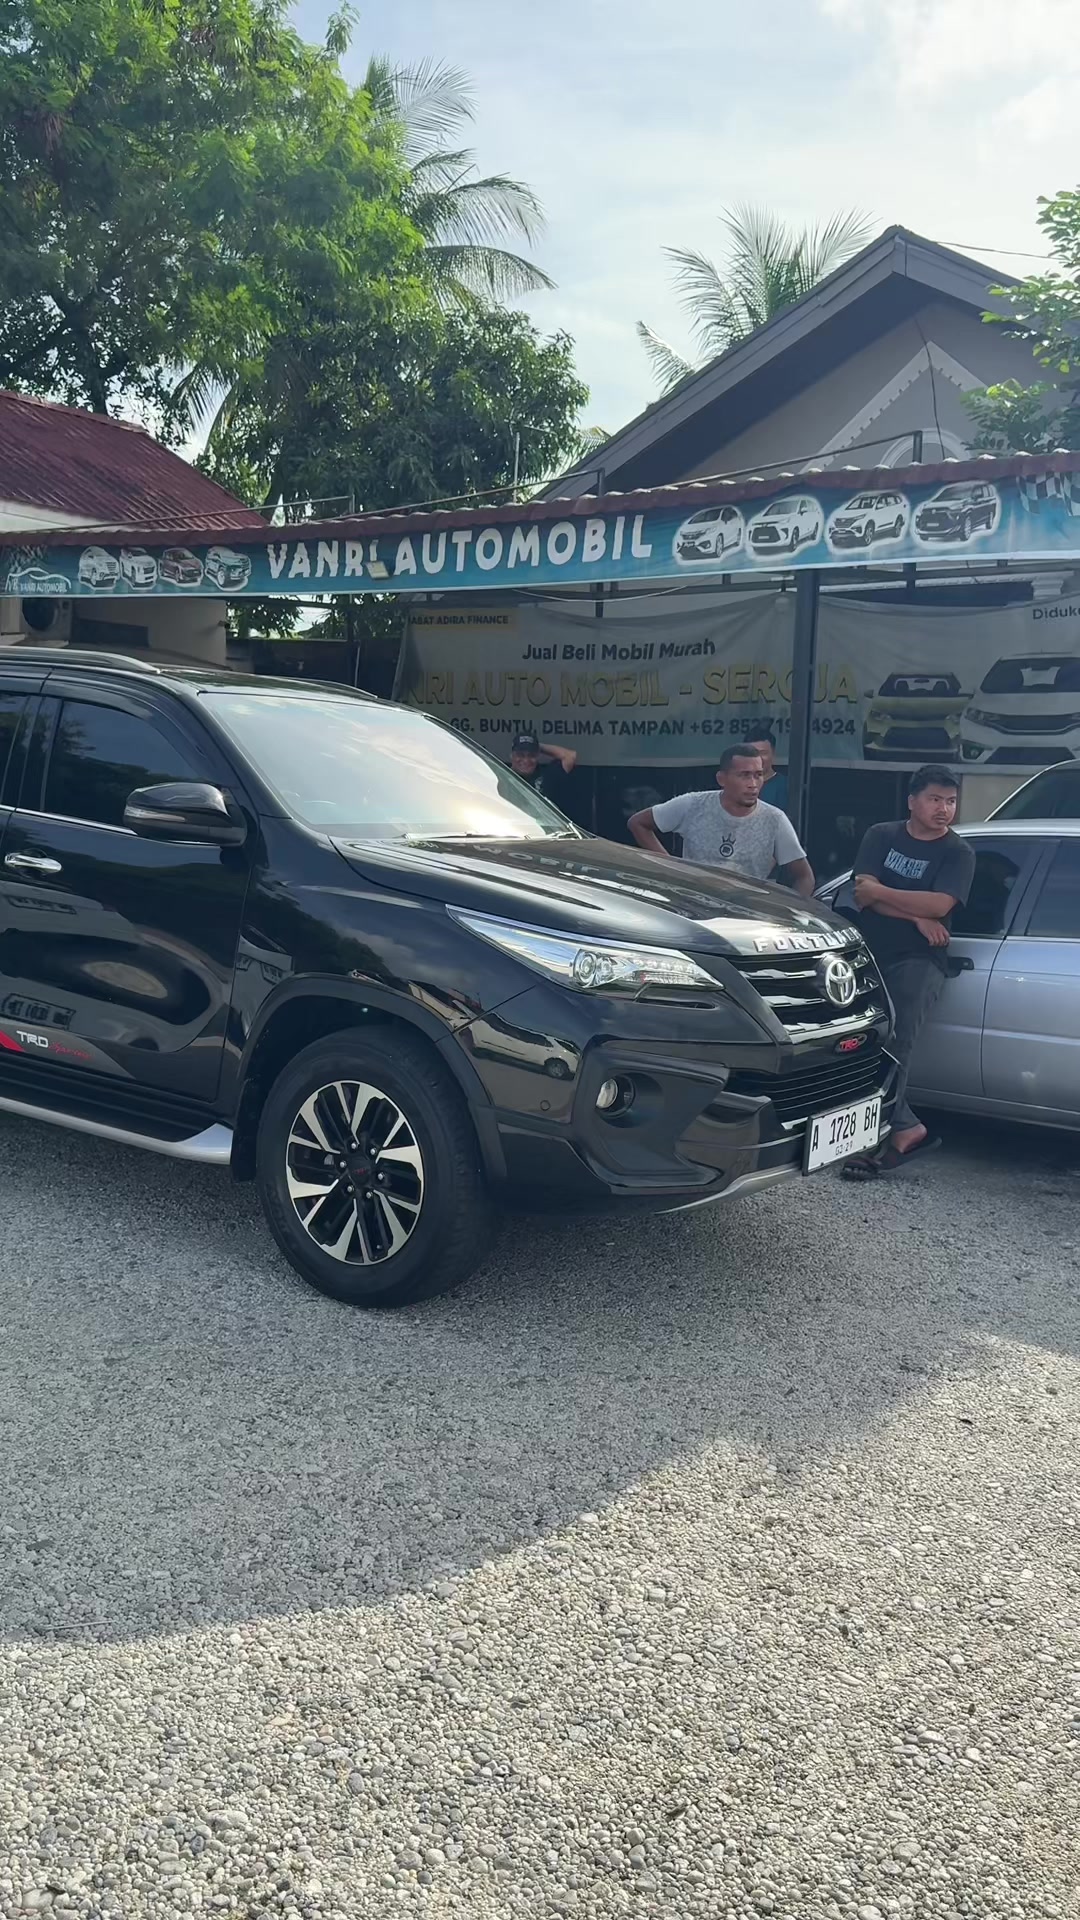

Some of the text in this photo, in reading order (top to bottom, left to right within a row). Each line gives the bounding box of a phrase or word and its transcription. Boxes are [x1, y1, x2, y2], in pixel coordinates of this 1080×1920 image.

[266, 513, 653, 580] VANRI AUTOMOBIL
[436, 615, 465, 625] ADIRA
[467, 615, 509, 625] FINANCE
[522, 638, 716, 661] Jual Beli Mobil Murah
[461, 671, 552, 707] AUTO
[560, 669, 670, 708] MOBIL
[542, 719, 603, 736] DELIMA
[608, 719, 684, 736] TAMPAN
[690, 718, 725, 736] +62
[753, 926, 863, 953] FORTUNER
[16, 1030, 49, 1049] TRD
[839, 1037, 859, 1050] TRD
[811, 1102, 879, 1153] A 1728 BH
